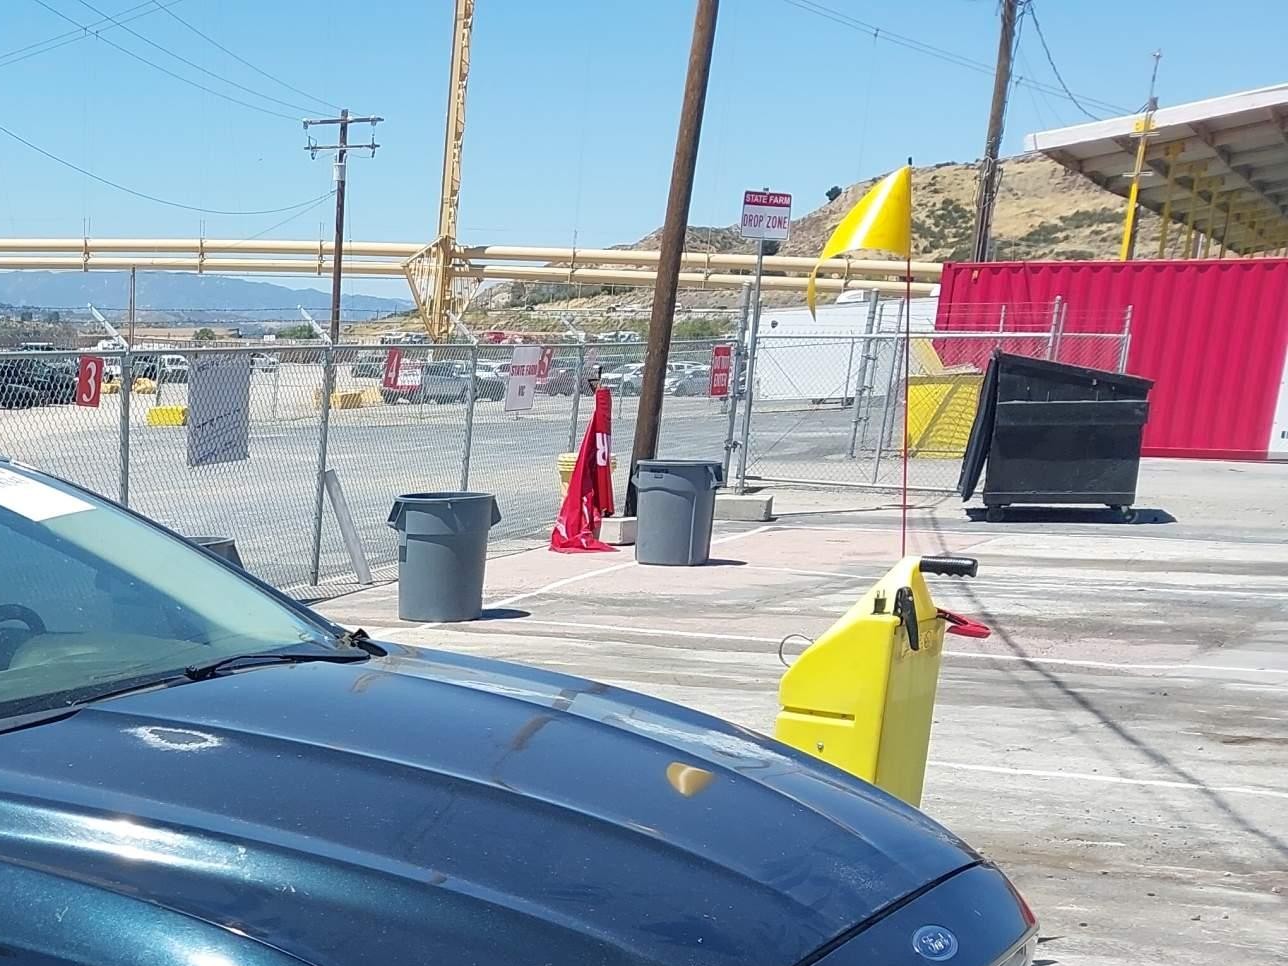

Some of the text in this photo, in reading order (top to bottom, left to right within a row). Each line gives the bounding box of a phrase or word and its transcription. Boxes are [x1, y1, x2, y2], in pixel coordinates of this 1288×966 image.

[745, 193, 790, 205] STATE FARM
[743, 214, 788, 229] DROP ZONE
[388, 351, 399, 385] 4
[511, 364, 525, 377] STATE
[82, 361, 97, 402] 3
